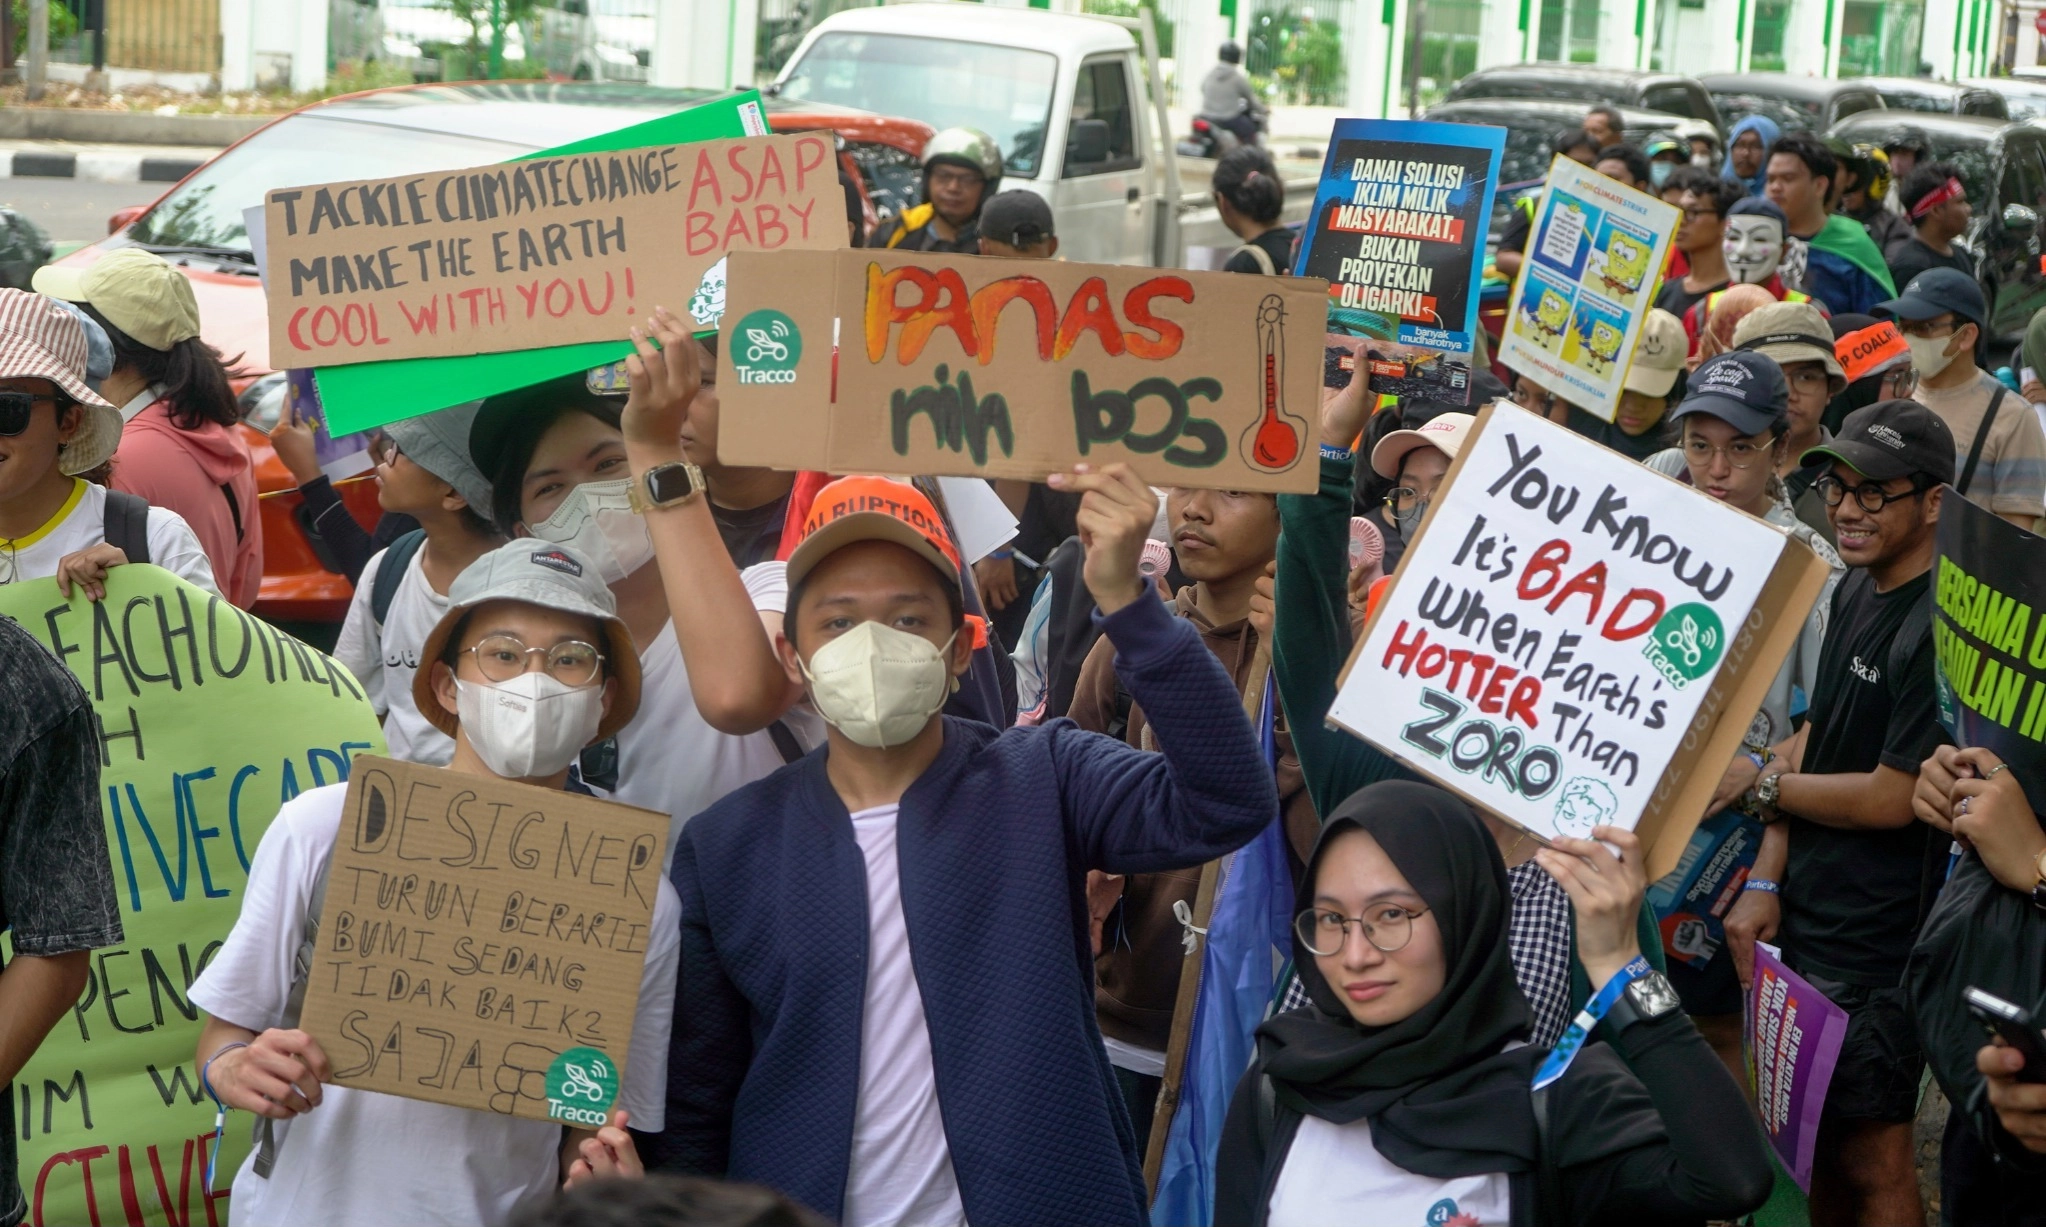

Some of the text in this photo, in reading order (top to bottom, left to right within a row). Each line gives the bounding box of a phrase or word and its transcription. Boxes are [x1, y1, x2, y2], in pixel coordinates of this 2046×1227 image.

[271, 178, 432, 236] TACKLE
[566, 147, 681, 206] CHANGE
[687, 137, 826, 212] ASAP
[1351, 158, 1465, 190] DANAI SOLUSI
[1352, 182, 1451, 213] IKLIM MILIK
[685, 197, 816, 256] BABY
[1336, 205, 1455, 242] MASYARAKAT,
[1359, 235, 1421, 265] BUKAN
[290, 216, 626, 297] MAKE THE EARTH
[1338, 257, 1433, 292] PROYEKAN
[288, 266, 635, 351] COOL WITH YOU!
[864, 260, 1195, 367] PANAS
[1340, 283, 1423, 317] OLIGARKI
[1400, 334, 1463, 350] mudharotnya
[1415, 326, 1449, 340] banyak
[735, 365, 797, 384] Tracco
[1487, 433, 1733, 601] You Know
[1452, 513, 1666, 641] It's BAD
[1936, 553, 2032, 660] BERSAMA
[1418, 576, 1668, 729] When Earth's
[1642, 635, 1690, 691] Tracco
[1382, 620, 1639, 787] HOTTER Than
[1400, 687, 1563, 801] ZORO
[350, 769, 657, 910] DESIGNER
[345, 866, 647, 953] TURUN BERARTI
[332, 910, 586, 992] BUMI SEDANG
[327, 961, 456, 1010] TIDAK
[1757, 974, 1774, 1040] JARANG
[1771, 976, 1788, 1016] KOK
[334, 1009, 483, 1091] SAJA
[1765, 1013, 1780, 1069] SUARA
[1779, 1004, 1797, 1054] NEGARA
[1791, 1025, 1803, 1046] EH
[547, 1098, 607, 1126] Tracco
